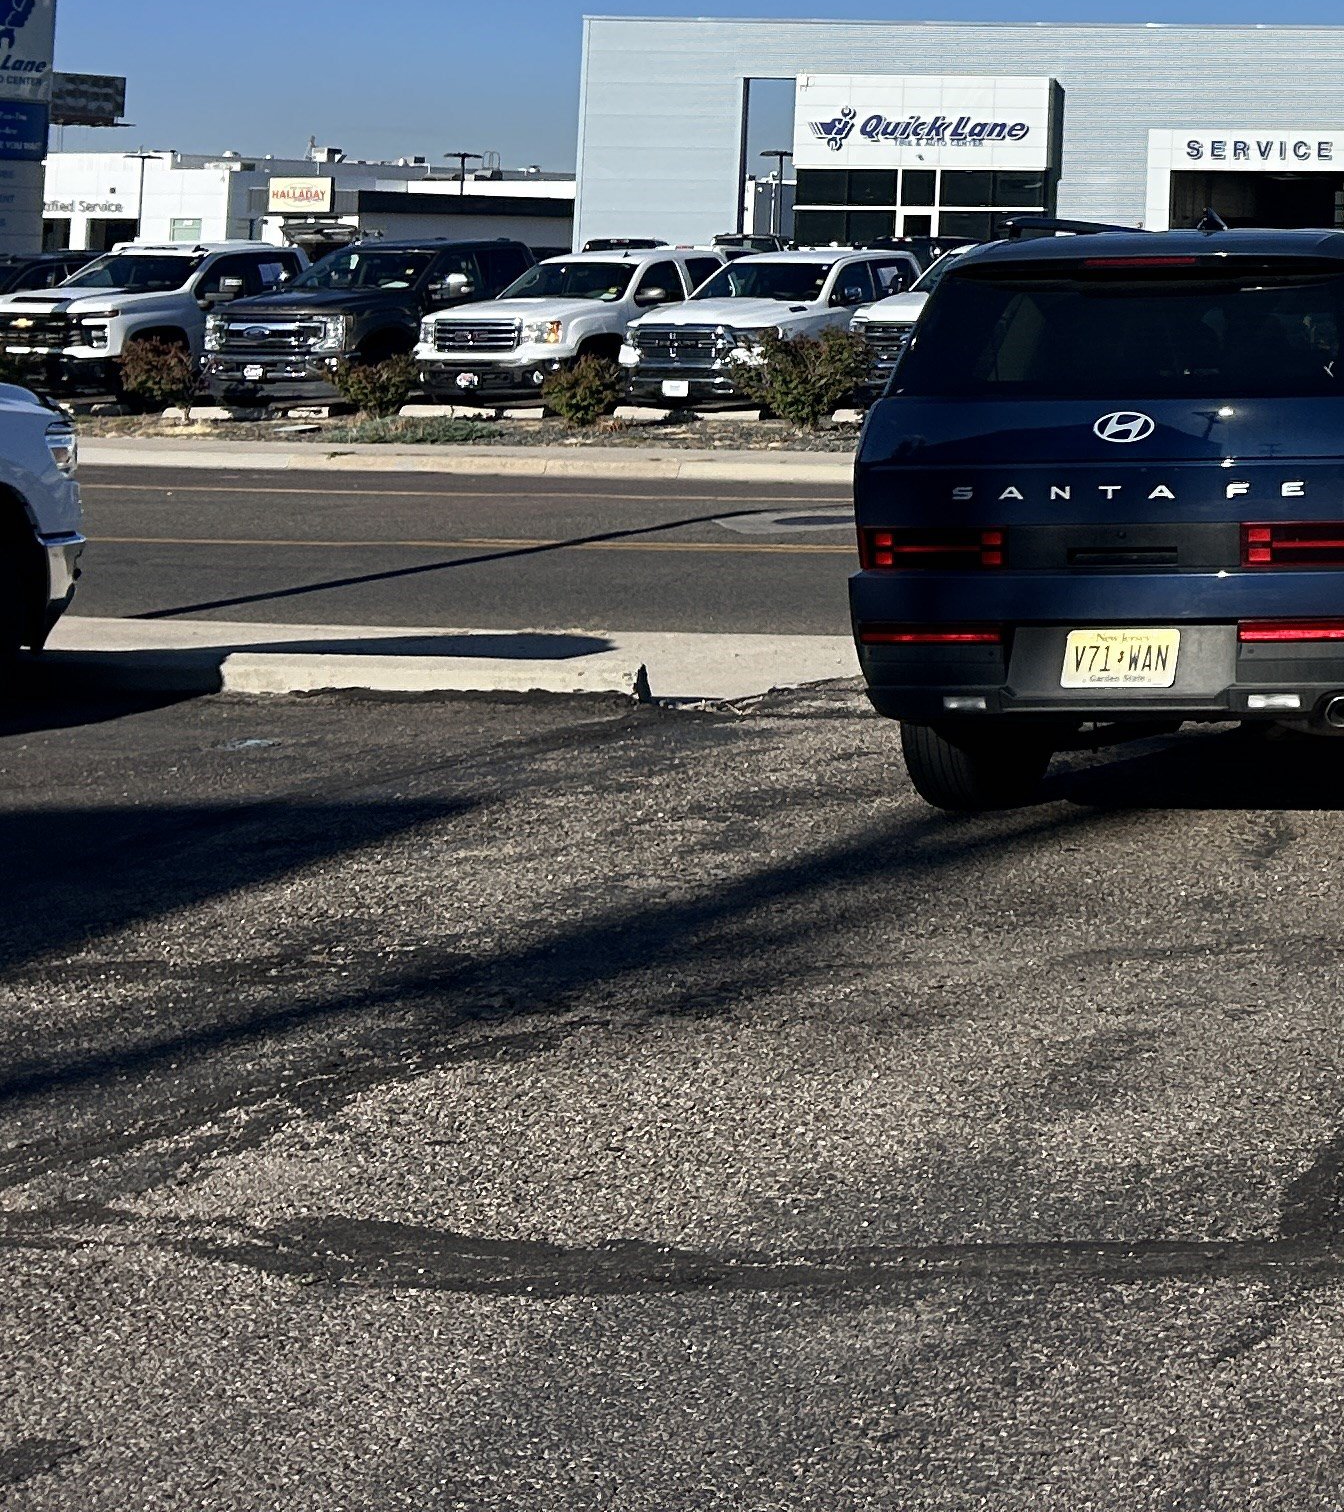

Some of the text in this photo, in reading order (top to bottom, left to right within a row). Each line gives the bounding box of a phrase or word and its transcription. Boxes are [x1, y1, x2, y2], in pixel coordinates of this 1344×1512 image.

[2, 55, 47, 73] Lane
[1186, 140, 1334, 161] SERVICE
[271, 189, 326, 201] HALLADAY
[79, 200, 123, 212] Service
[952, 481, 1305, 500] SANTA FE
